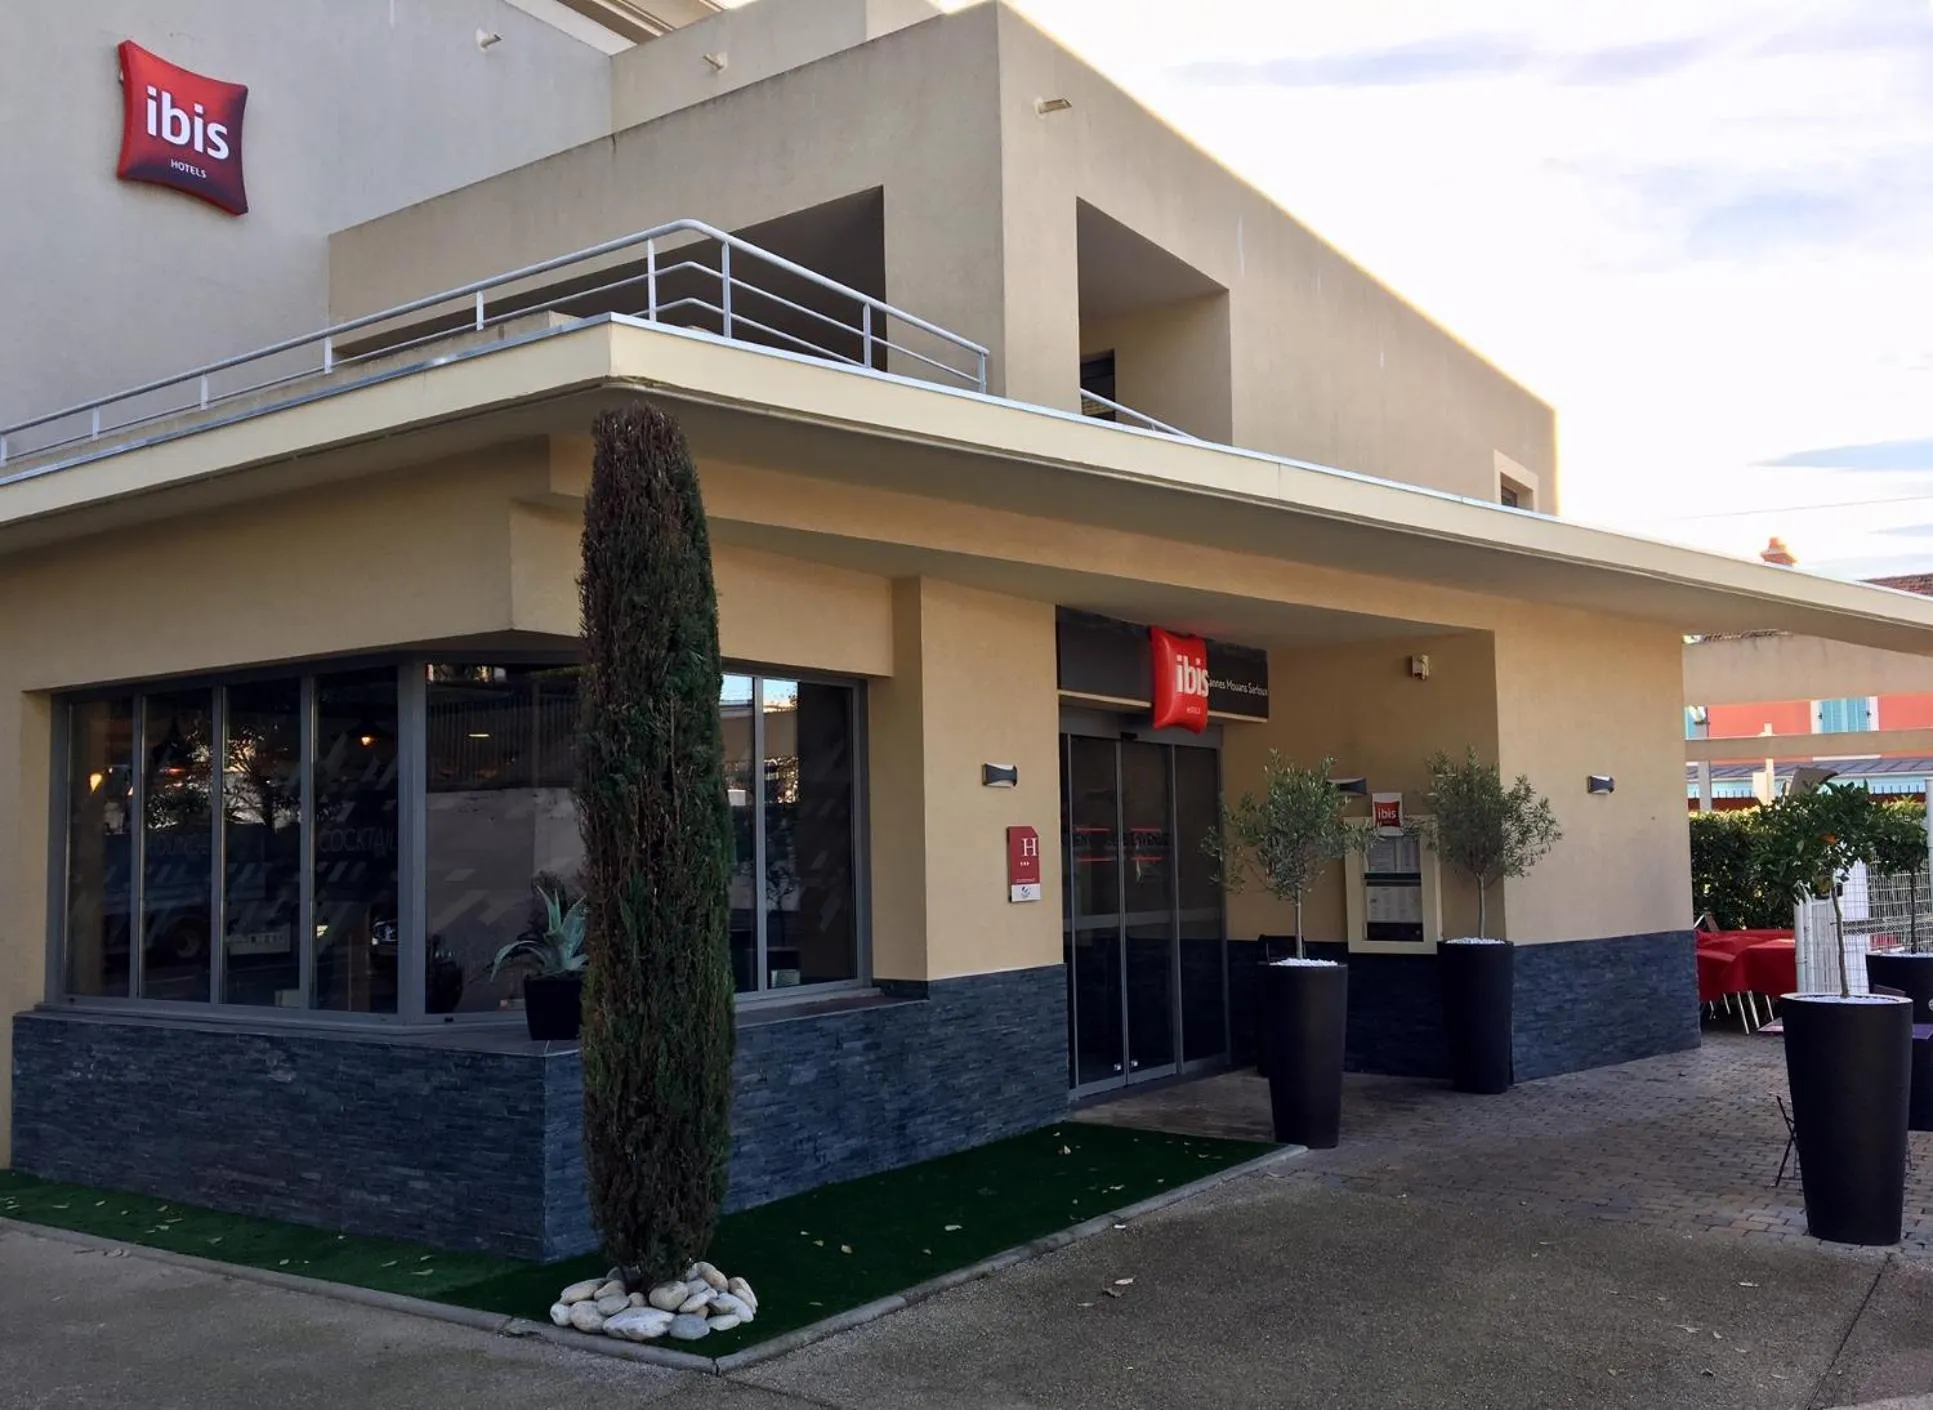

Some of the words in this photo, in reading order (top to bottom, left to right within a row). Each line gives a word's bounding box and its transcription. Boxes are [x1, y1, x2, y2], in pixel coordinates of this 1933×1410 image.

[147, 85, 229, 160] ibis
[170, 159, 207, 178] HOTELS
[1176, 655, 1209, 697] ibis
[1378, 807, 1396, 819] ibis
[1022, 838, 1037, 856] H
